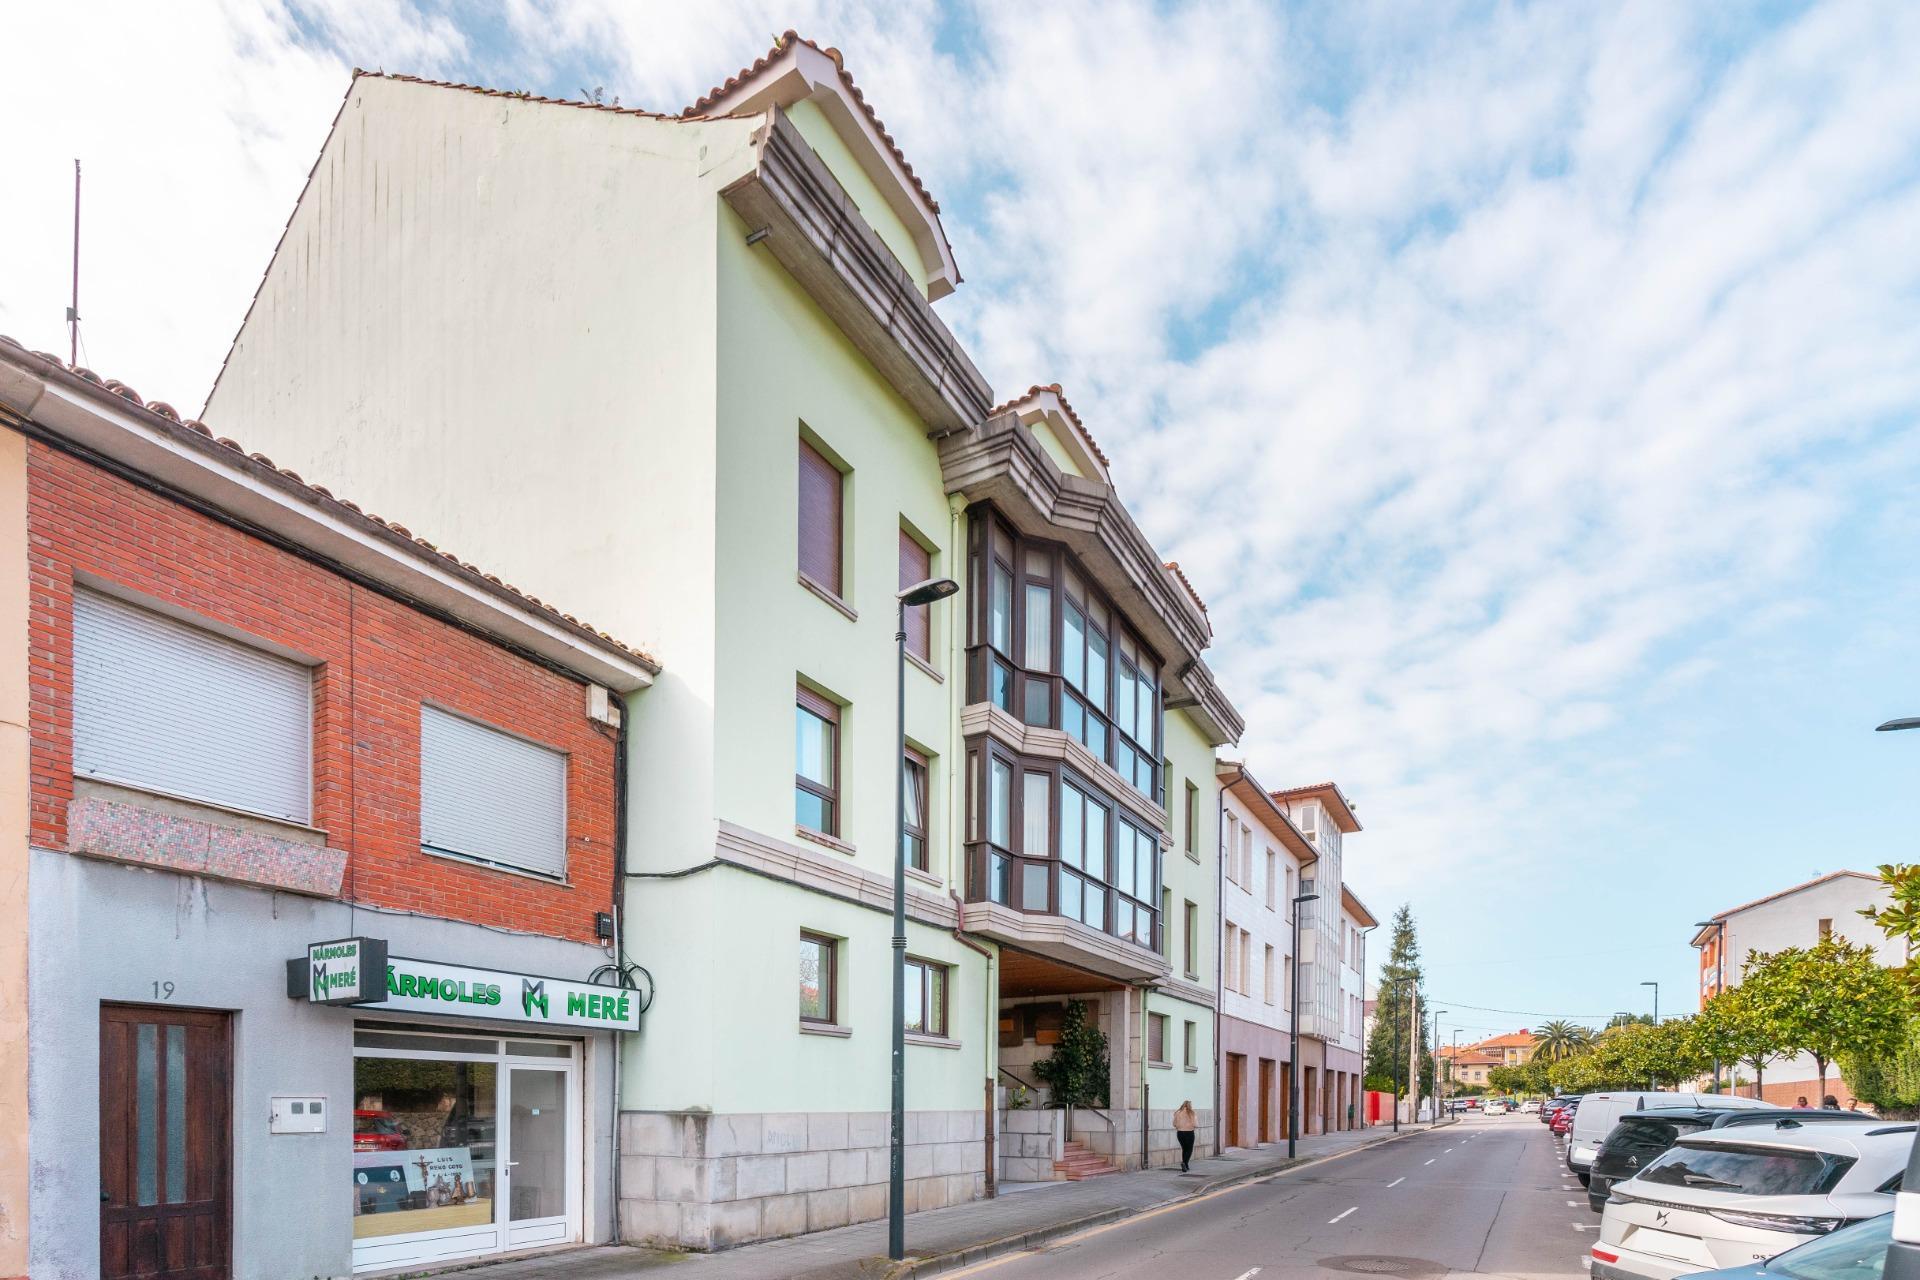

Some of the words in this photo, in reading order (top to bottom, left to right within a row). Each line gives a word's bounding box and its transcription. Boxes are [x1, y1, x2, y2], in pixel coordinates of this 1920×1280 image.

[313, 944, 357, 961] MÁRMOLES
[330, 966, 356, 988] MERÉ
[152, 981, 175, 1000] 19
[386, 965, 501, 1007] ÁRMOLES
[567, 990, 630, 1022] MERÉ
